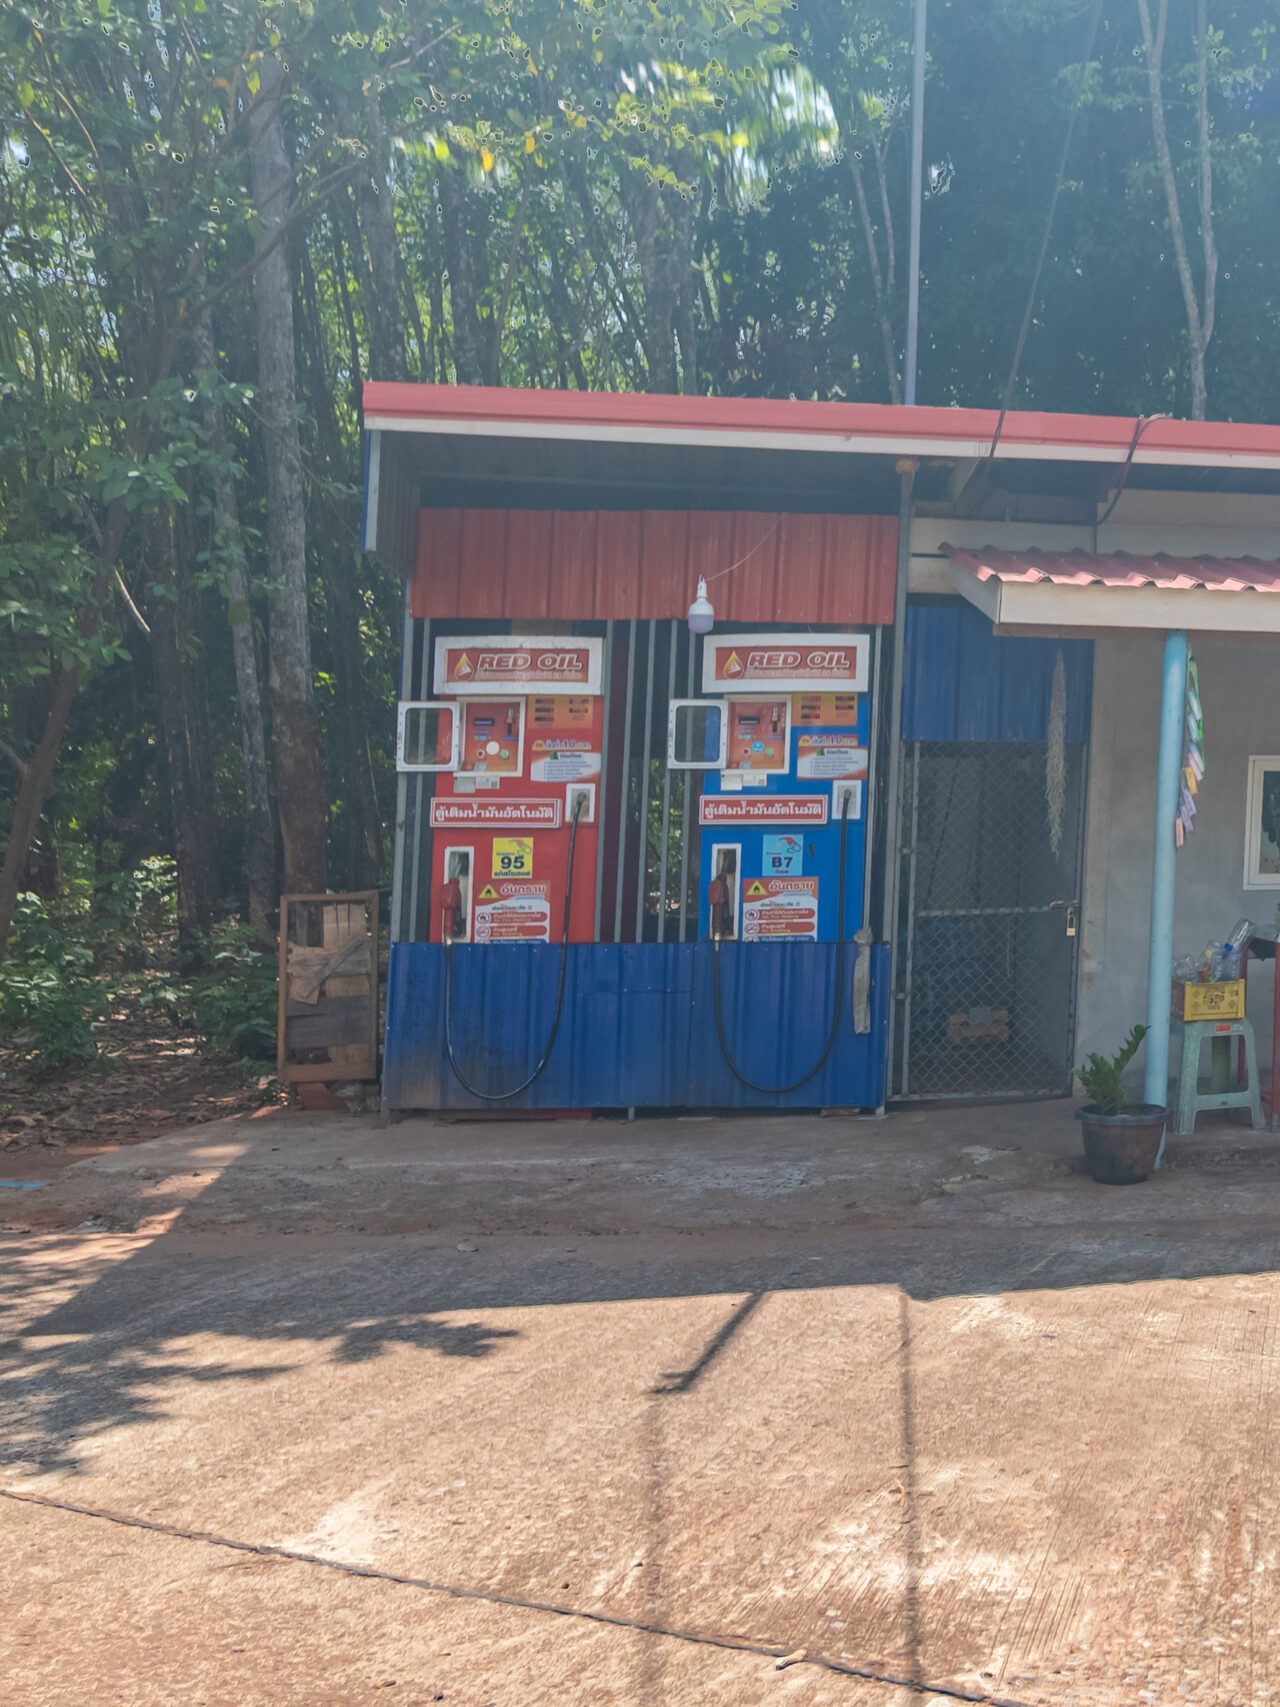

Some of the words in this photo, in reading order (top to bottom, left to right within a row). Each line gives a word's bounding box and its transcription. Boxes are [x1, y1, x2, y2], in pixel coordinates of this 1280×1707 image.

[477, 653, 532, 671] RED
[537, 653, 583, 671] OIL
[746, 651, 801, 669] RED
[806, 651, 850, 669] OIL
[563, 738, 576, 748] 10
[829, 735, 843, 745] 10
[435, 802, 553, 822] ตู้เติมน้ำมันอัตโนมัติ
[704, 800, 821, 819] ตู้เติมน้ำมันอัตโนมัติ
[500, 855, 525, 870] 95
[771, 856, 793, 869] B7
[500, 883, 547, 895] อันตราย
[768, 880, 814, 892] อันตราย
